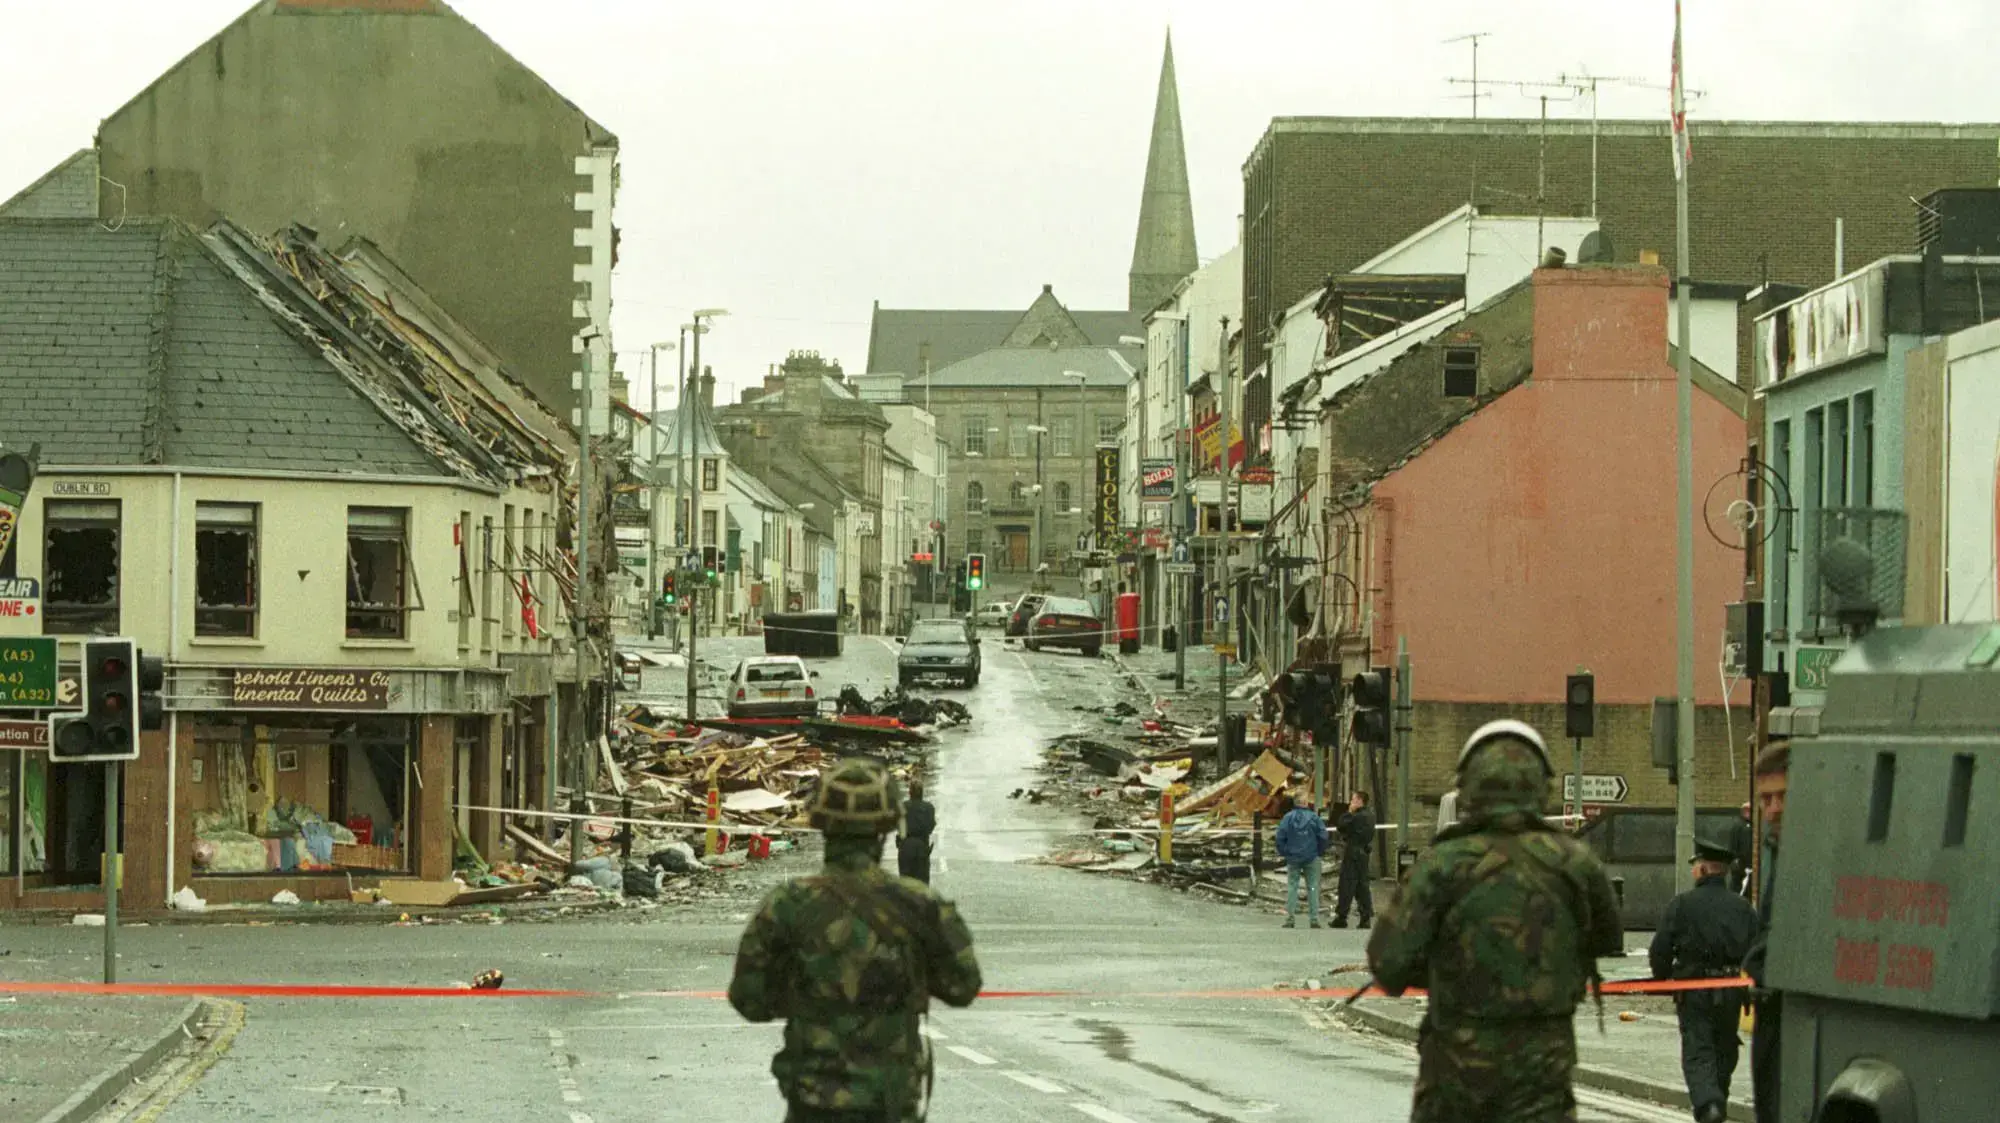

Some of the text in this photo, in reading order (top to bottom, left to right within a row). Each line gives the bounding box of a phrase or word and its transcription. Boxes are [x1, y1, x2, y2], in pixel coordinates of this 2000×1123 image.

[1143, 466, 1174, 486] SOLD
[56, 483, 88, 494] DUBLIN
[0, 600, 22, 617] NE
[4, 649, 35, 662] (A5)
[294, 671, 356, 687] Linens
[12, 688, 50, 701] (A32)
[311, 687, 367, 703] Quilts
[1595, 777, 1614, 787] Park
